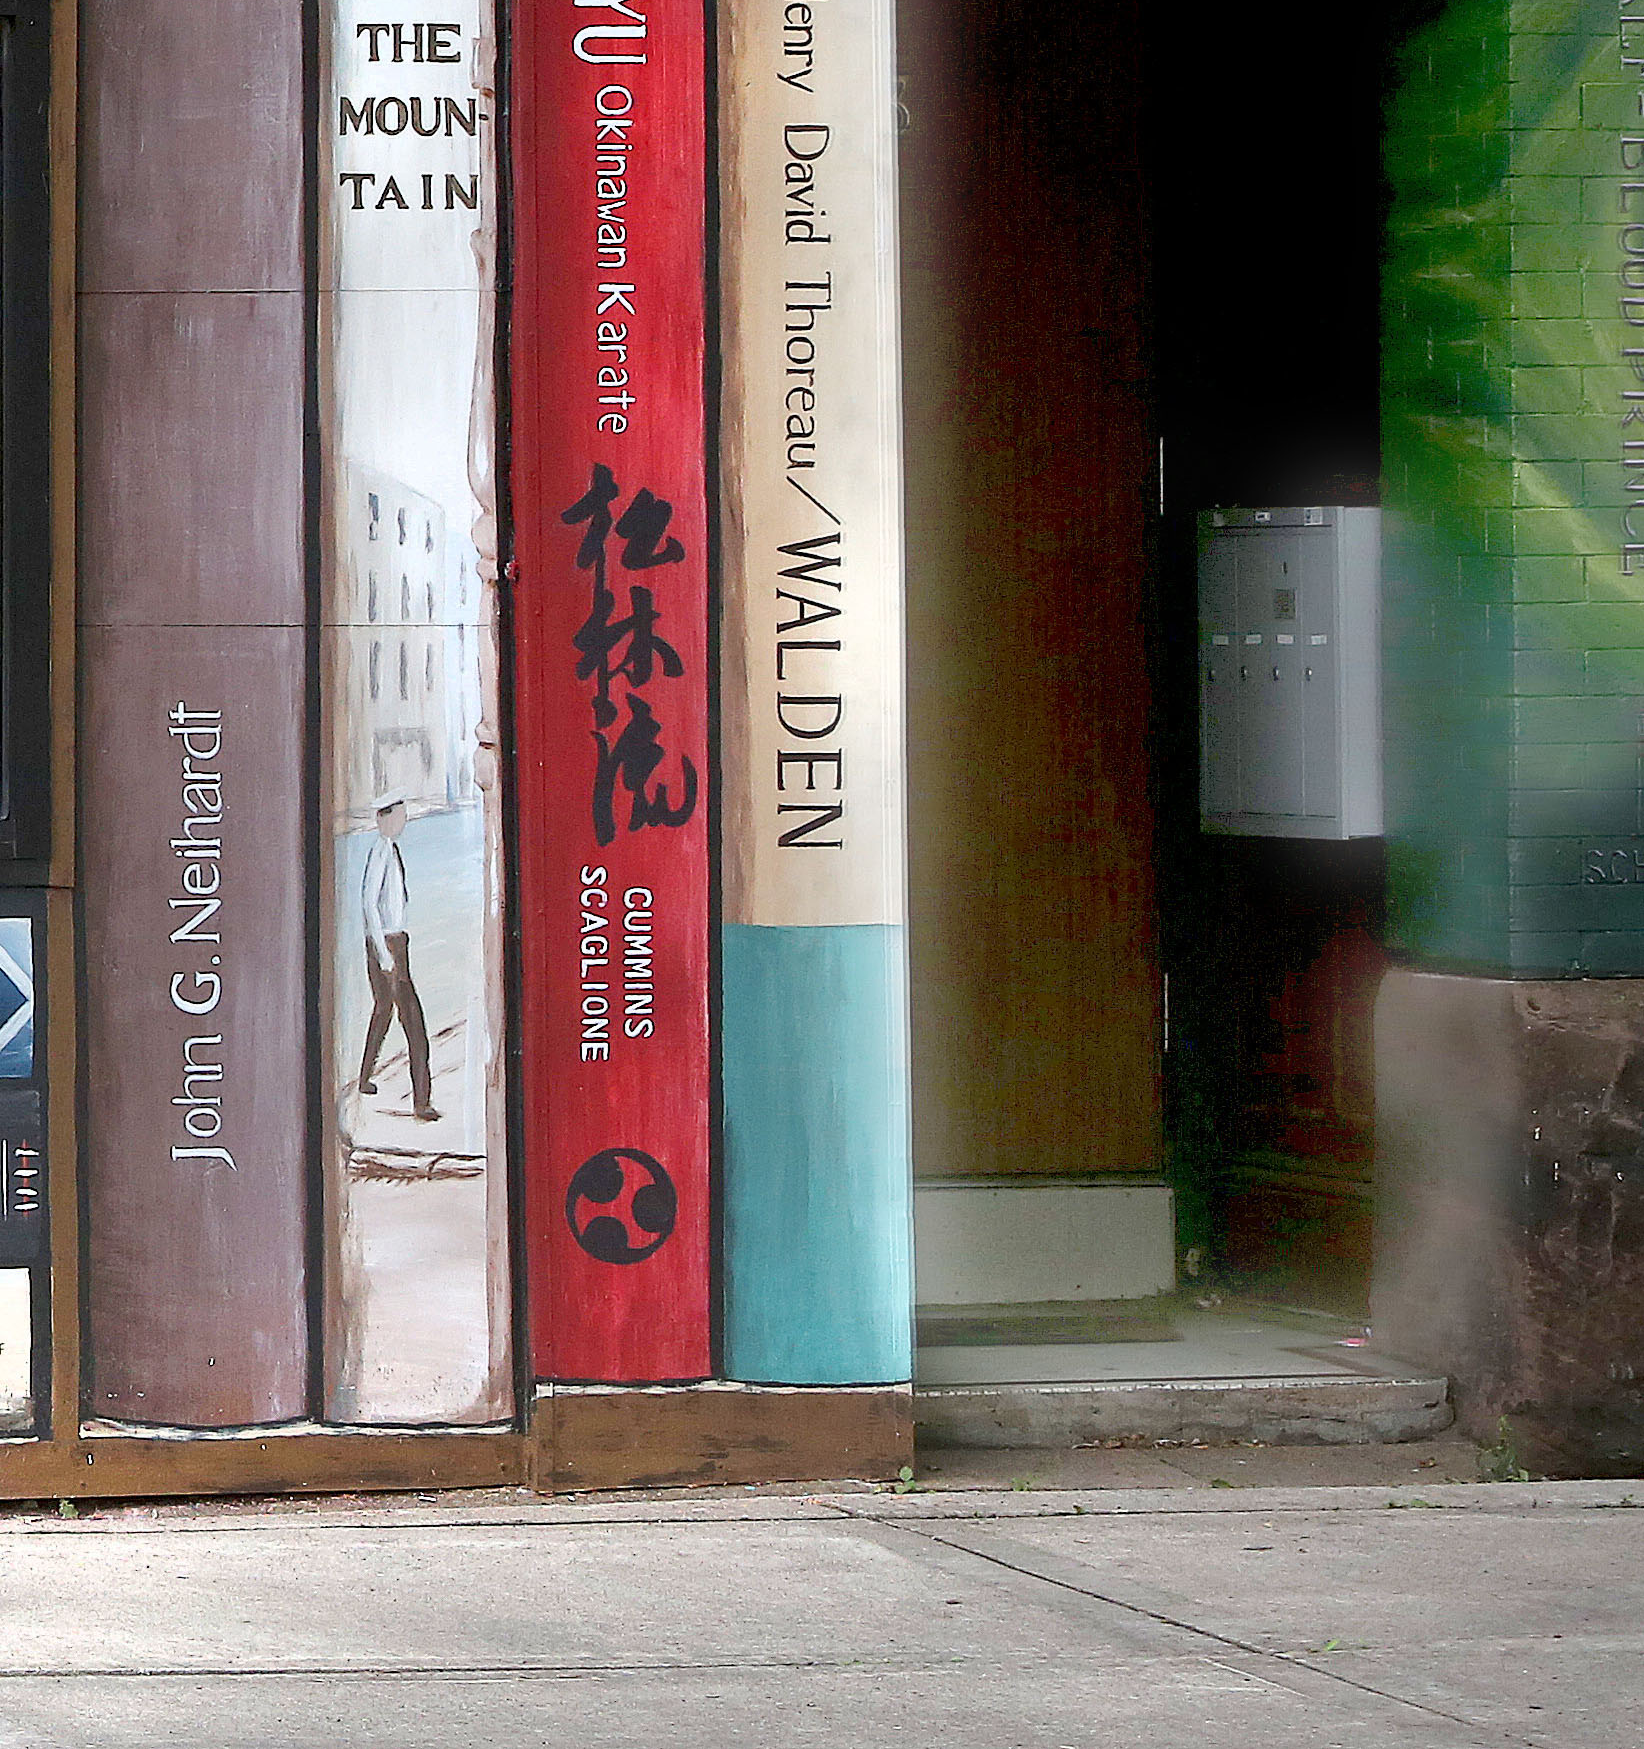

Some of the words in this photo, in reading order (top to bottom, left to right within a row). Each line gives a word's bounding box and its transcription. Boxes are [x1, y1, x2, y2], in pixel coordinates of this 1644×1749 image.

[357, 23, 461, 63] THE
[339, 97, 490, 138] MOUN-
[595, 84, 634, 269] Okinawan
[782, 122, 832, 246] David
[340, 173, 479, 210] TAIN
[596, 281, 636, 435] Karate
[579, 865, 610, 1063] SCAGLIONE
[624, 886, 653, 1040] CUMMINS
[169, 1033, 237, 1171] John
